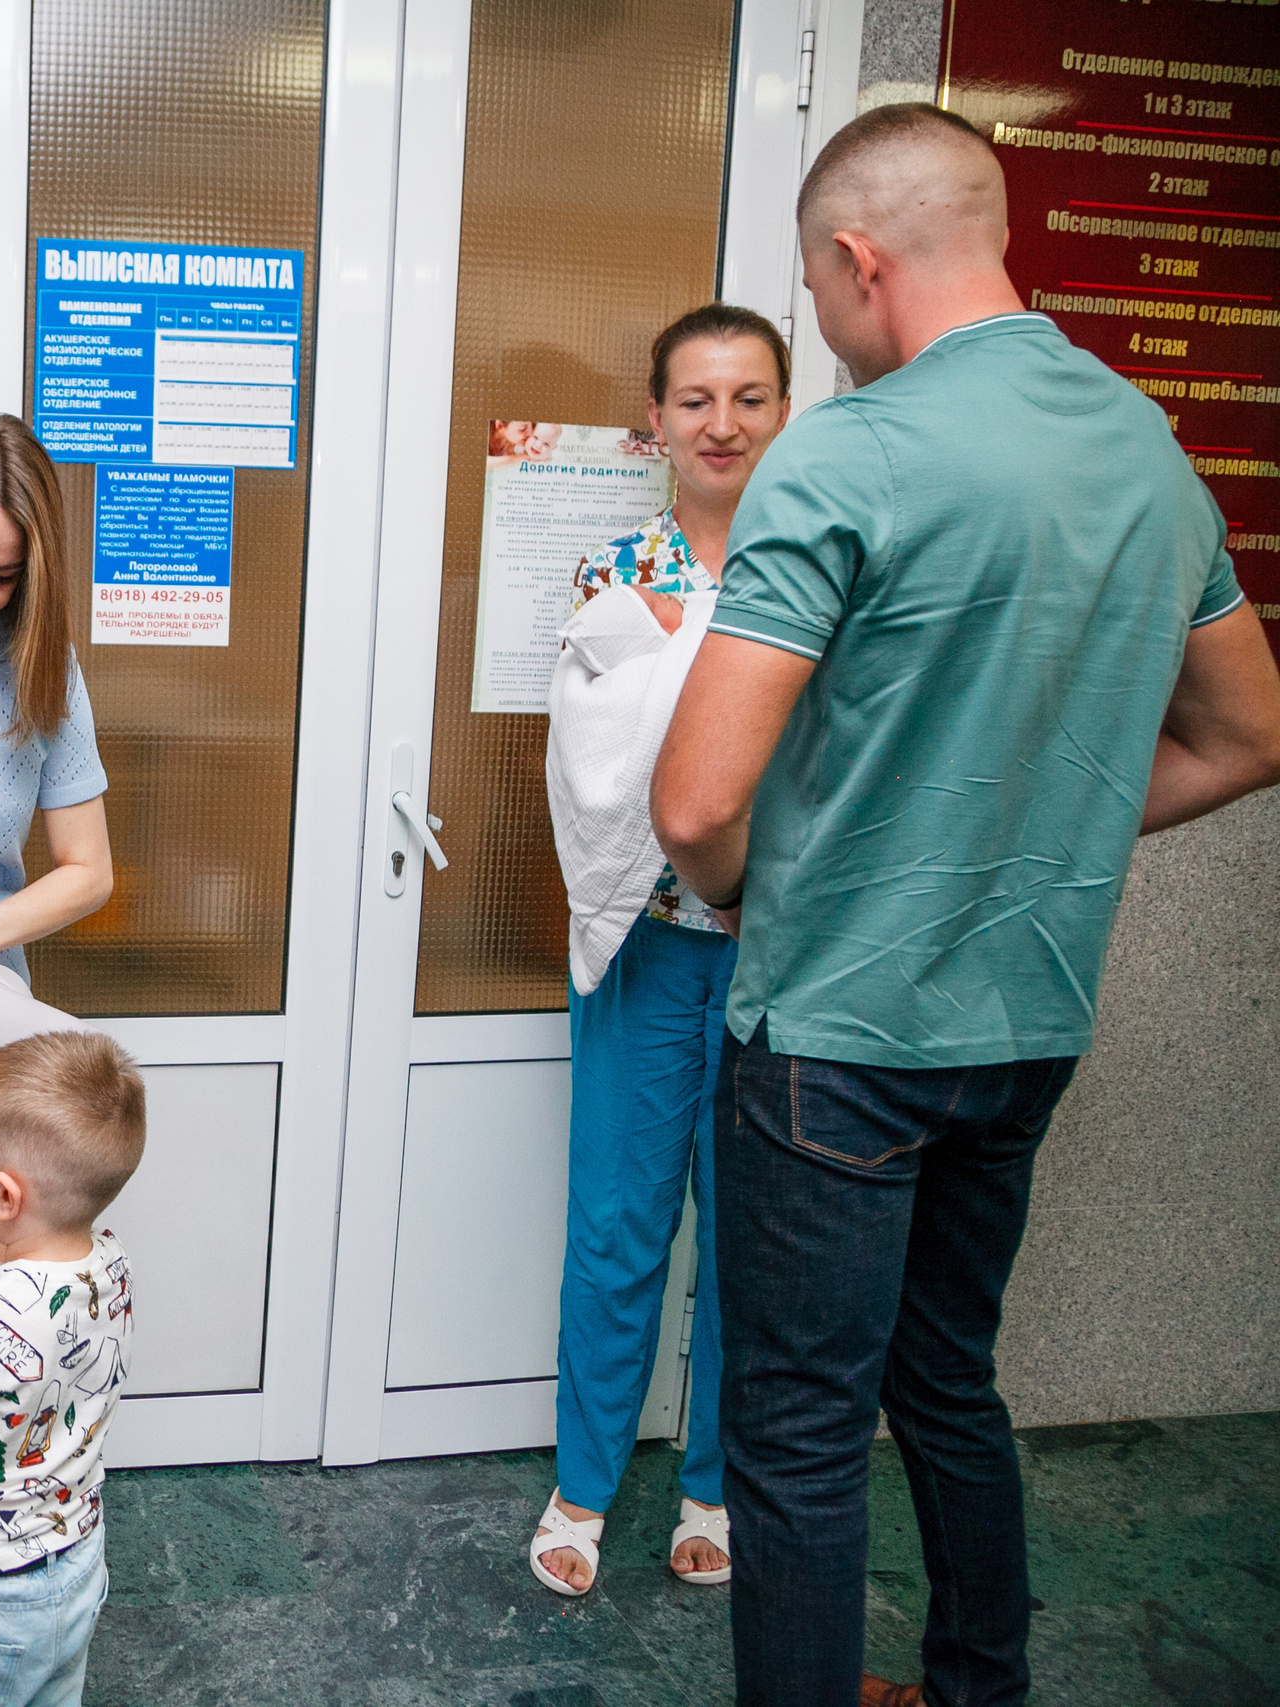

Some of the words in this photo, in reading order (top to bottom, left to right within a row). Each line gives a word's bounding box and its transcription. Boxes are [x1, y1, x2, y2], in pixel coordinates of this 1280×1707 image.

[1062, 48, 1164, 79] Отделение
[1144, 92, 1154, 113] 1
[1155, 97, 1168, 114] и
[1171, 94, 1183, 116] 3
[1185, 99, 1233, 119] этаж
[993, 121, 1268, 166] Акушерско-физиологическое
[1148, 172, 1160, 193] 2
[1162, 175, 1209, 197] этаж
[1046, 210, 1198, 242] Обсервационное
[45, 249, 180, 285] ВЫПИСНАЯ
[185, 254, 295, 290] КОМНАТА
[1139, 253, 1151, 275] 3
[1154, 256, 1199, 278] этаж
[1031, 289, 1196, 321] Гинекологическое
[44, 334, 111, 345] АКУШЕРСКОЕ
[1128, 332, 1140, 354] 4
[1143, 336, 1188, 357] этаж
[43, 345, 143, 357] ФИЗИОЛОГИЧЕСКОЕ
[43, 356, 102, 366] ОТДЕЛЕНИЕ
[43, 377, 110, 388] АКУШЕРСКОЕ
[43, 388, 137, 399] ОБСЕРВАЦИОННОЕ
[1189, 381, 1280, 404] пребыван
[43, 399, 101, 409] ОТДЕЛЕНИЕ
[42, 421, 91, 431] ОТДЕЛЕНИЕ
[120, 443, 147, 453] ДЕТЕЙ
[519, 461, 576, 474] Дорогие
[581, 467, 649, 479] родители!
[107, 471, 170, 481] УВАЖАЕМЫЕ
[174, 473, 229, 484] МАМОЧКИ!
[129, 561, 198, 573] Погореловой
[113, 571, 140, 581] Анне
[143, 571, 216, 583] Валентиновне
[100, 588, 146, 604] 8(918)
[151, 590, 224, 603] 492-29-05
[129, 611, 182, 620] ПРОБЛЕМЫ
[193, 613, 227, 621] ОБЯЗА-
[100, 620, 144, 628] ТЕЛЬНОМ
[147, 621, 189, 629] ПОРЯДКЕ
[191, 622, 220, 630] БУДУТ
[130, 630, 192, 638] РАЗРЕШЕНЫ!
